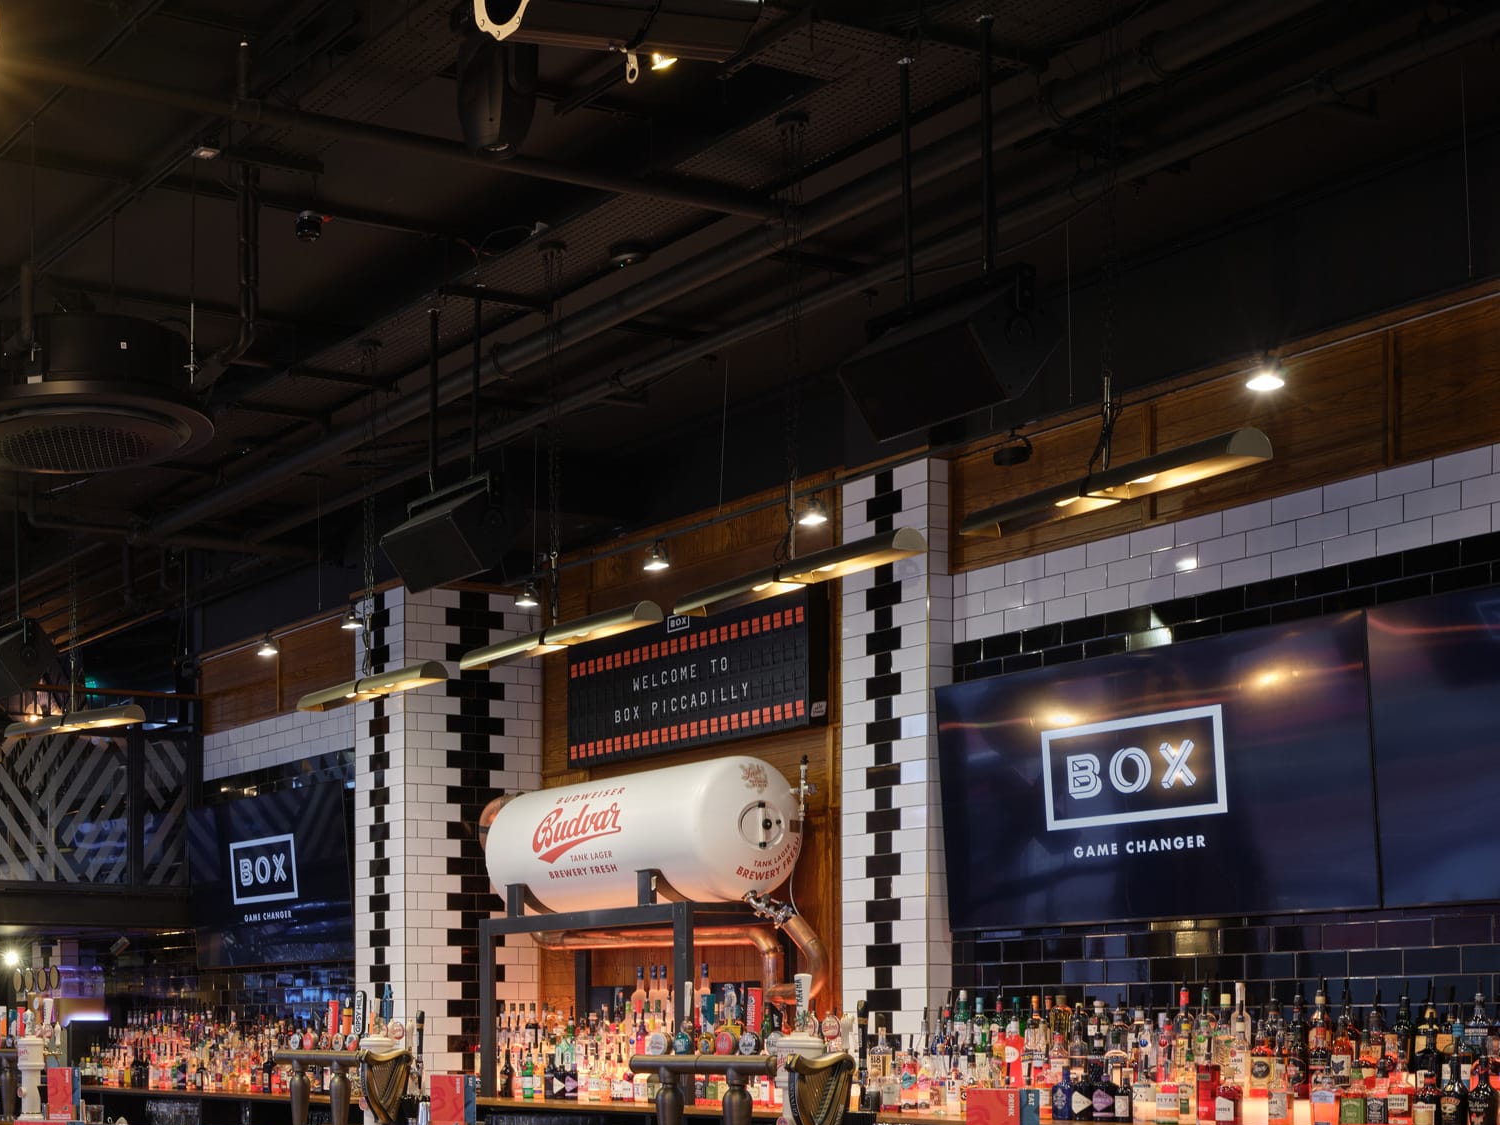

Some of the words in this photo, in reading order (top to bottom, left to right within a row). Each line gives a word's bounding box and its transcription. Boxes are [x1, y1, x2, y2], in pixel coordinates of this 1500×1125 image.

[670, 617, 687, 628] BOX
[632, 664, 697, 692] WELCOME
[710, 657, 728, 673] TO
[614, 708, 640, 724] BOX
[651, 682, 749, 716] PICCADILLY
[1066, 739, 1197, 800] BOX
[556, 787, 625, 805] BUDWEISER
[532, 802, 622, 858] Budvar
[1073, 843, 1118, 859] GAME
[1125, 834, 1207, 855] CHANGER
[570, 853, 589, 862] TANK
[590, 850, 613, 860] LAGER
[754, 860, 772, 868] TANK
[239, 853, 287, 886] BOX
[548, 867, 588, 880] BREWERY
[590, 863, 618, 875] FRESH
[736, 866, 780, 880] BREWERY
[244, 913, 261, 922] GAME
[262, 910, 292, 921] CHANGER
